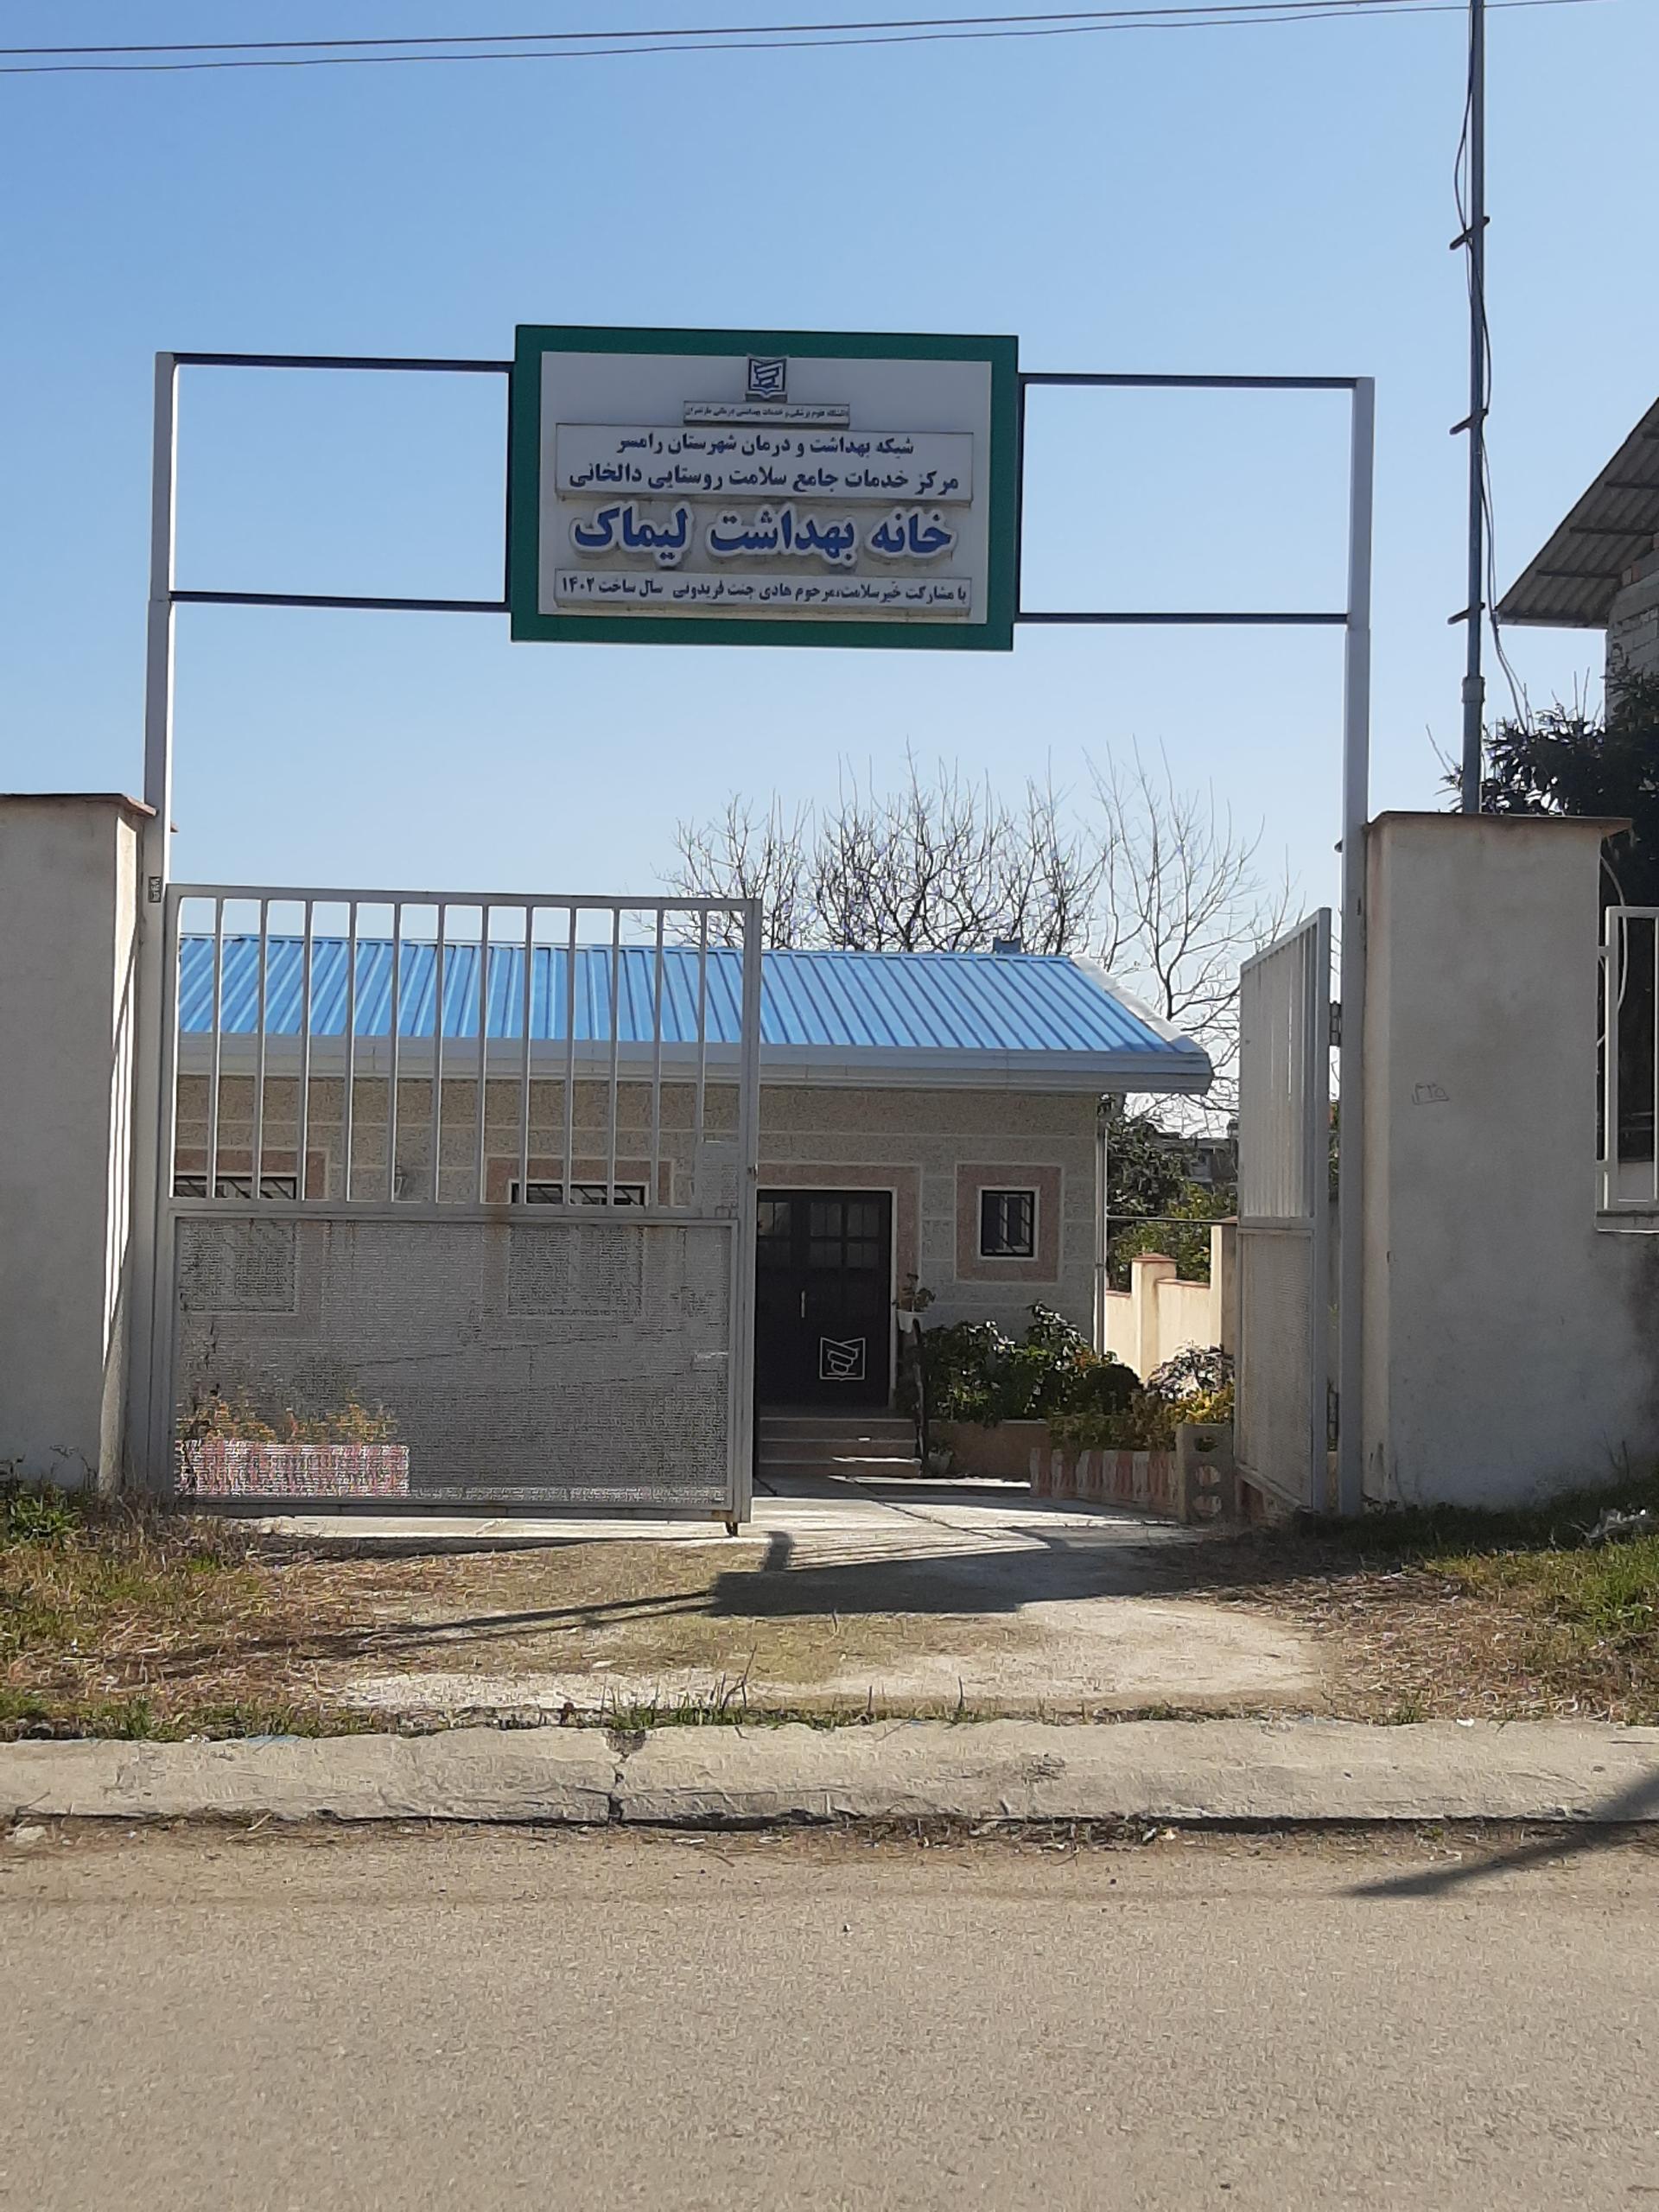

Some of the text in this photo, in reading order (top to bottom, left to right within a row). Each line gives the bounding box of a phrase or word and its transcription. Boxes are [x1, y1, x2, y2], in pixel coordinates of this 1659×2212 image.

[616, 432, 914, 459] شبکه بهداشت و درمان شهرستان رامسر
[569, 462, 959, 495] مرکز خدمات جامع سلامت روستایی دالخانی
[574, 505, 953, 560] خانه بهداشت لیماک
[599, 577, 636, 594] ساخت
[639, 579, 664, 598] سال
[672, 580, 724, 601] فریدونی
[727, 585, 754, 601] جنت
[759, 583, 791, 601] هادی
[905, 585, 955, 605] مشارکت
[957, 585, 967, 604] با
